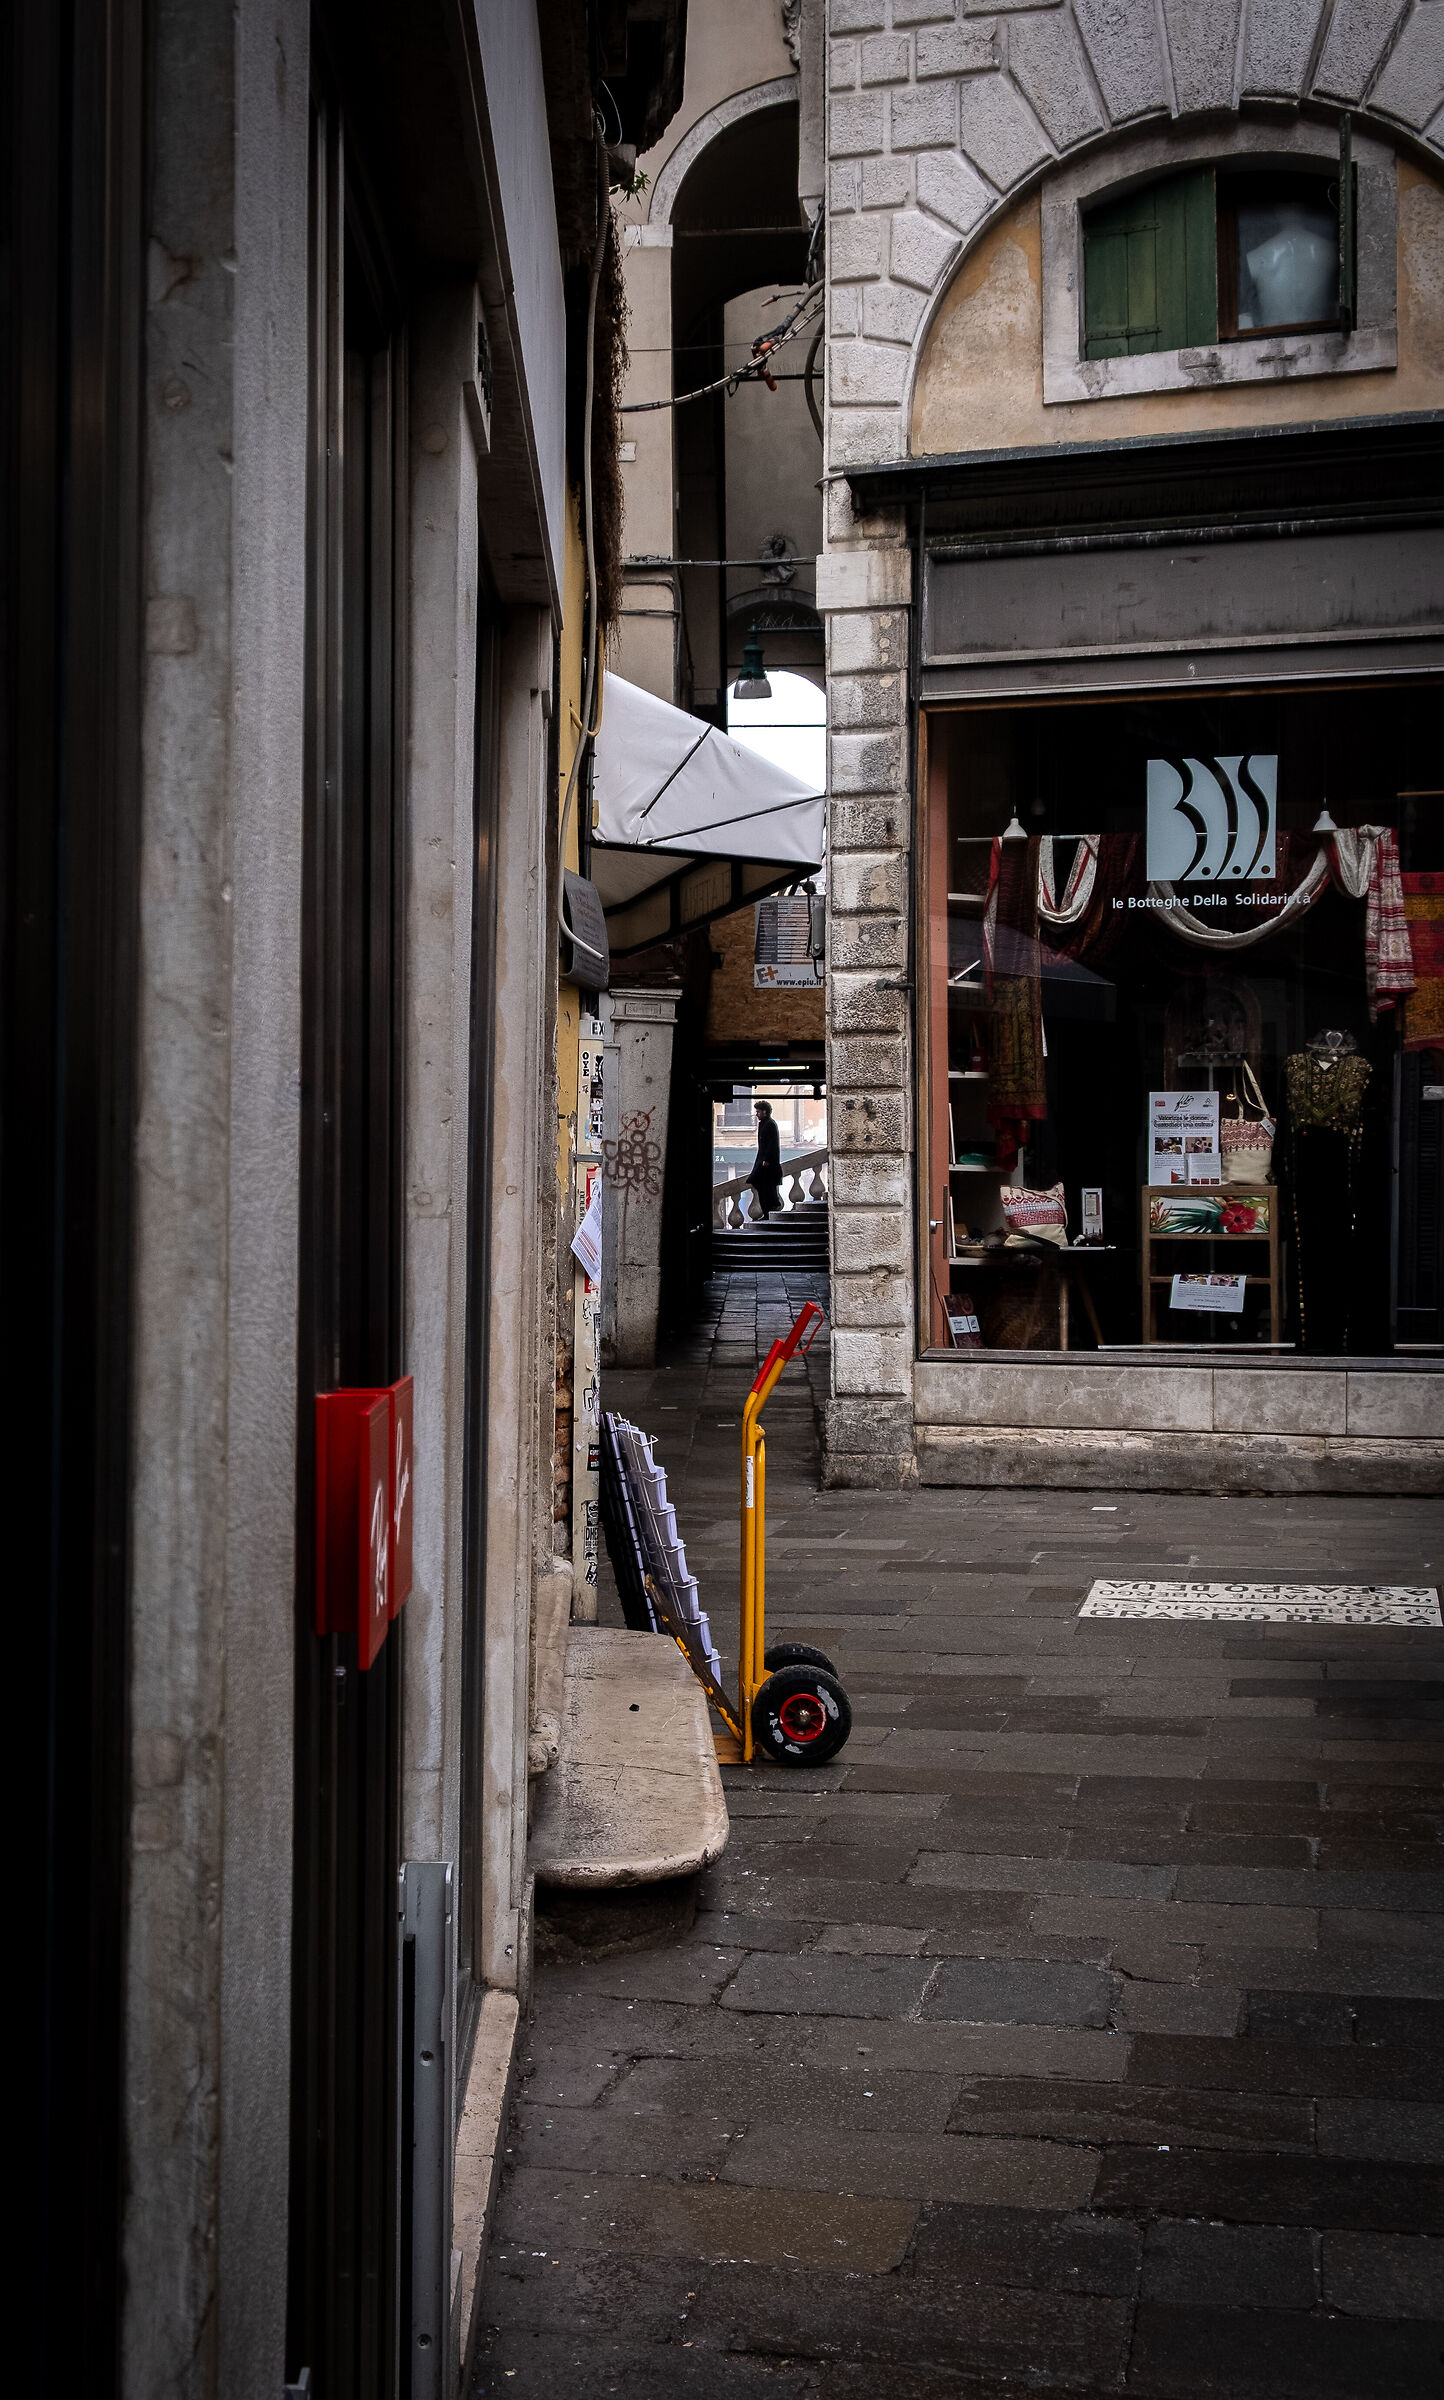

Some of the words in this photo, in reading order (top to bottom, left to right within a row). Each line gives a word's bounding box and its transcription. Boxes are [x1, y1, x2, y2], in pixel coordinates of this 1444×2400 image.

[1112, 897, 1124, 909] le
[1128, 896, 1189, 910] Botteghe
[1193, 894, 1228, 907] Della
[1089, 1609, 1271, 1622] GRASPO
